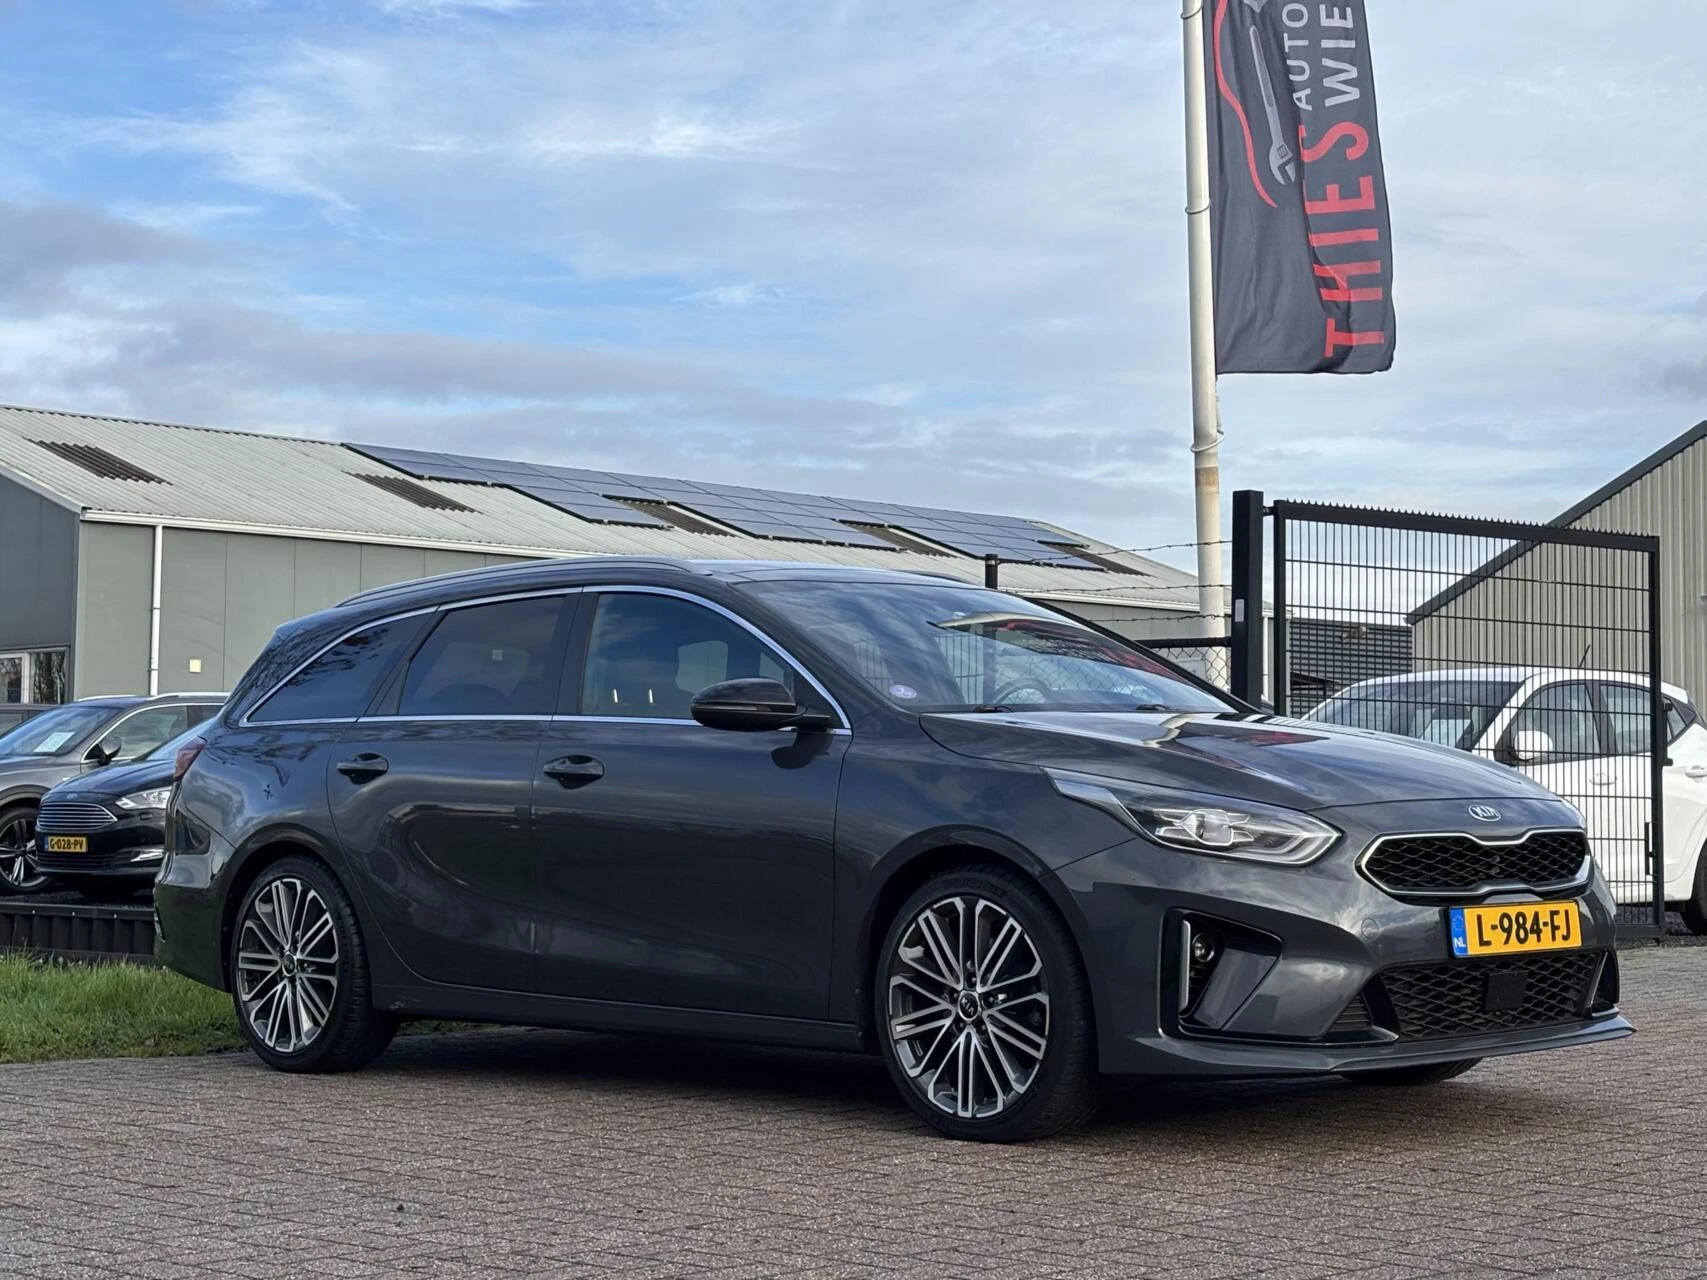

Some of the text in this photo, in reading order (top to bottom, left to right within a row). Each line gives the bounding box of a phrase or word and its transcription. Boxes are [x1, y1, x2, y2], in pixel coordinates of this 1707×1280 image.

[1282, 2, 1312, 111] AUTO
[1298, 122, 1385, 358] THIES
[1471, 806, 1500, 817] KIA
[50, 838, 84, 850] G-028-PV
[1476, 909, 1571, 947] L-984-FJ
[1454, 936, 1467, 948] NL
